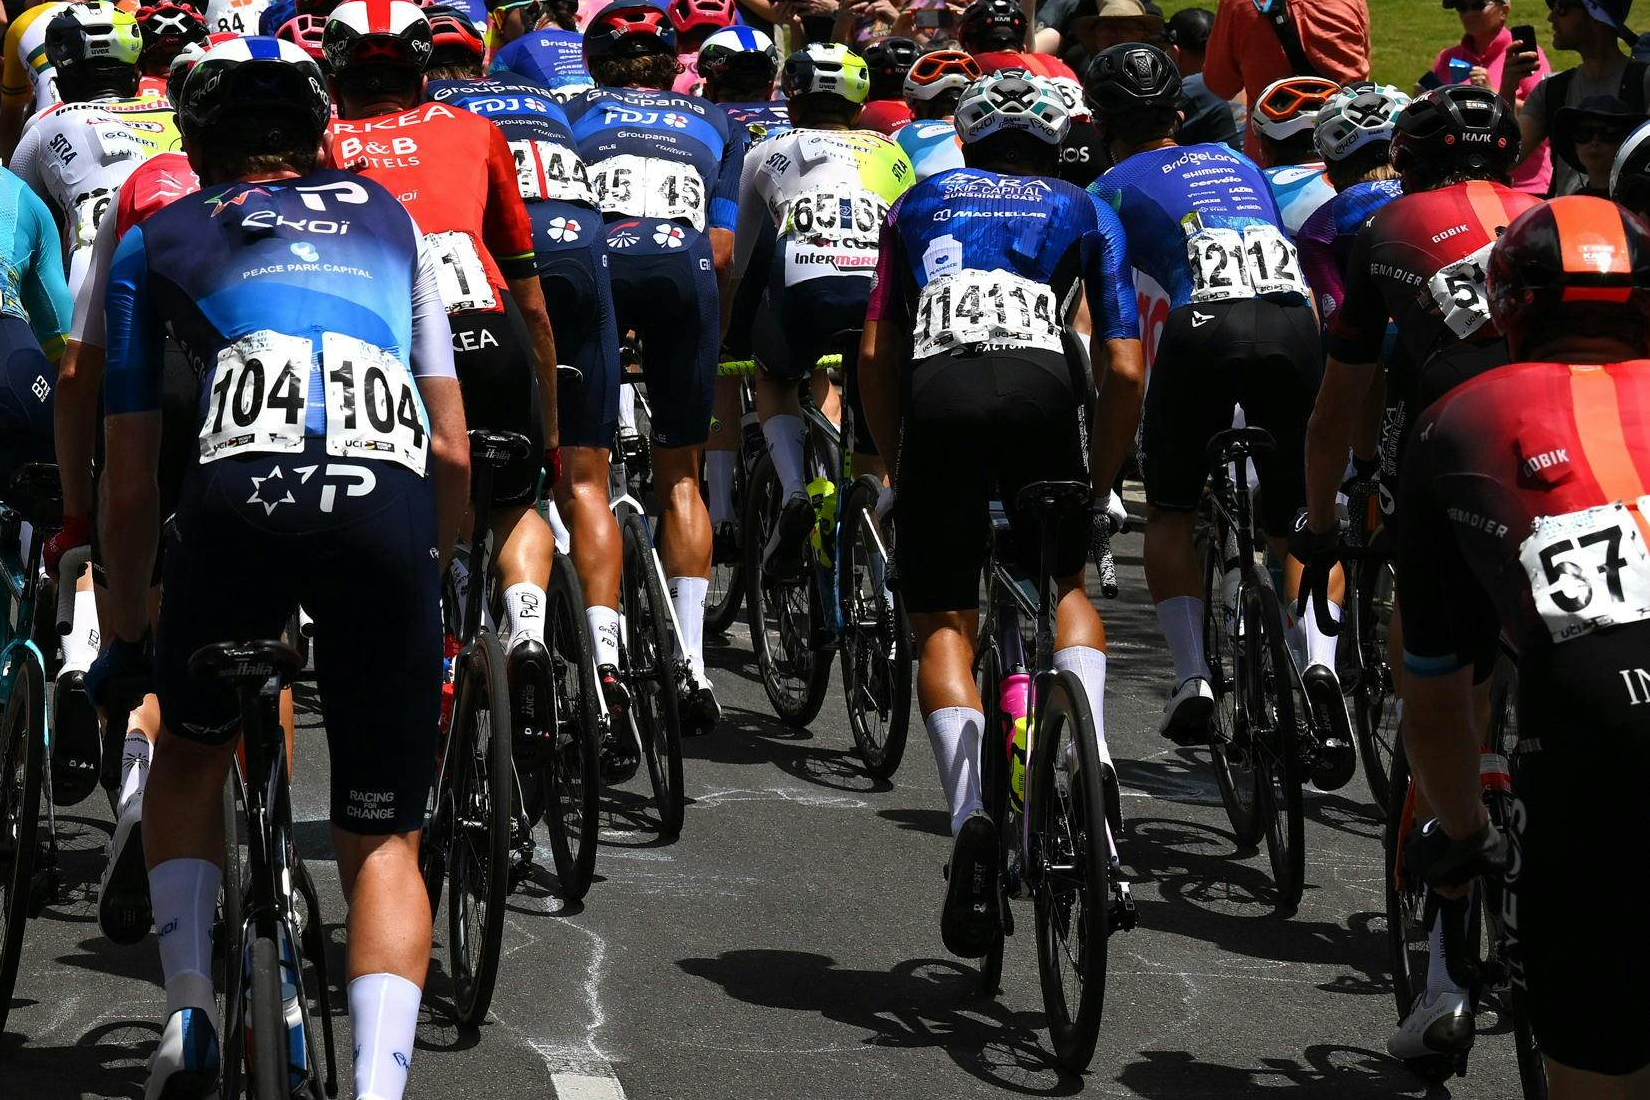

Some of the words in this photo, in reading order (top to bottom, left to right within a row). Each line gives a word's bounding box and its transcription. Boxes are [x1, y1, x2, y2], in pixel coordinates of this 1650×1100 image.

[218, 13, 245, 33] 84
[90, 47, 110, 55] uvex
[434, 84, 551, 100] Groupama
[469, 98, 520, 114] FDJ
[587, 90, 706, 116] Groupama
[333, 105, 455, 135] RKEA
[605, 106, 659, 125] FDJ
[493, 119, 548, 128] Groupama
[617, 131, 677, 144] Groupama
[1462, 132, 1492, 143] KASK
[341, 137, 418, 160] B&B
[344, 155, 421, 169] HOTELS
[1162, 152, 1241, 175] BridgeLane
[1182, 167, 1236, 180] SHIMANO
[658, 175, 701, 210] 45
[943, 191, 1003, 200] SUNSHINE
[945, 183, 982, 195] SKIP
[983, 185, 1043, 196] CAPITAL
[794, 194, 838, 233] 65
[1431, 224, 1470, 244] GOBIK
[243, 263, 285, 280] PEACE
[287, 263, 321, 273] PARK
[323, 264, 373, 280] CAPITAL
[211, 358, 304, 434] 104
[330, 360, 425, 449] 104
[213, 441, 227, 450] UCI
[345, 439, 362, 448] UCI
[1537, 524, 1629, 613] 57
[1560, 623, 1583, 638] UCI
[350, 789, 395, 804] RACING
[346, 805, 396, 820] CHANGE
[363, 802, 378, 810] FOR
